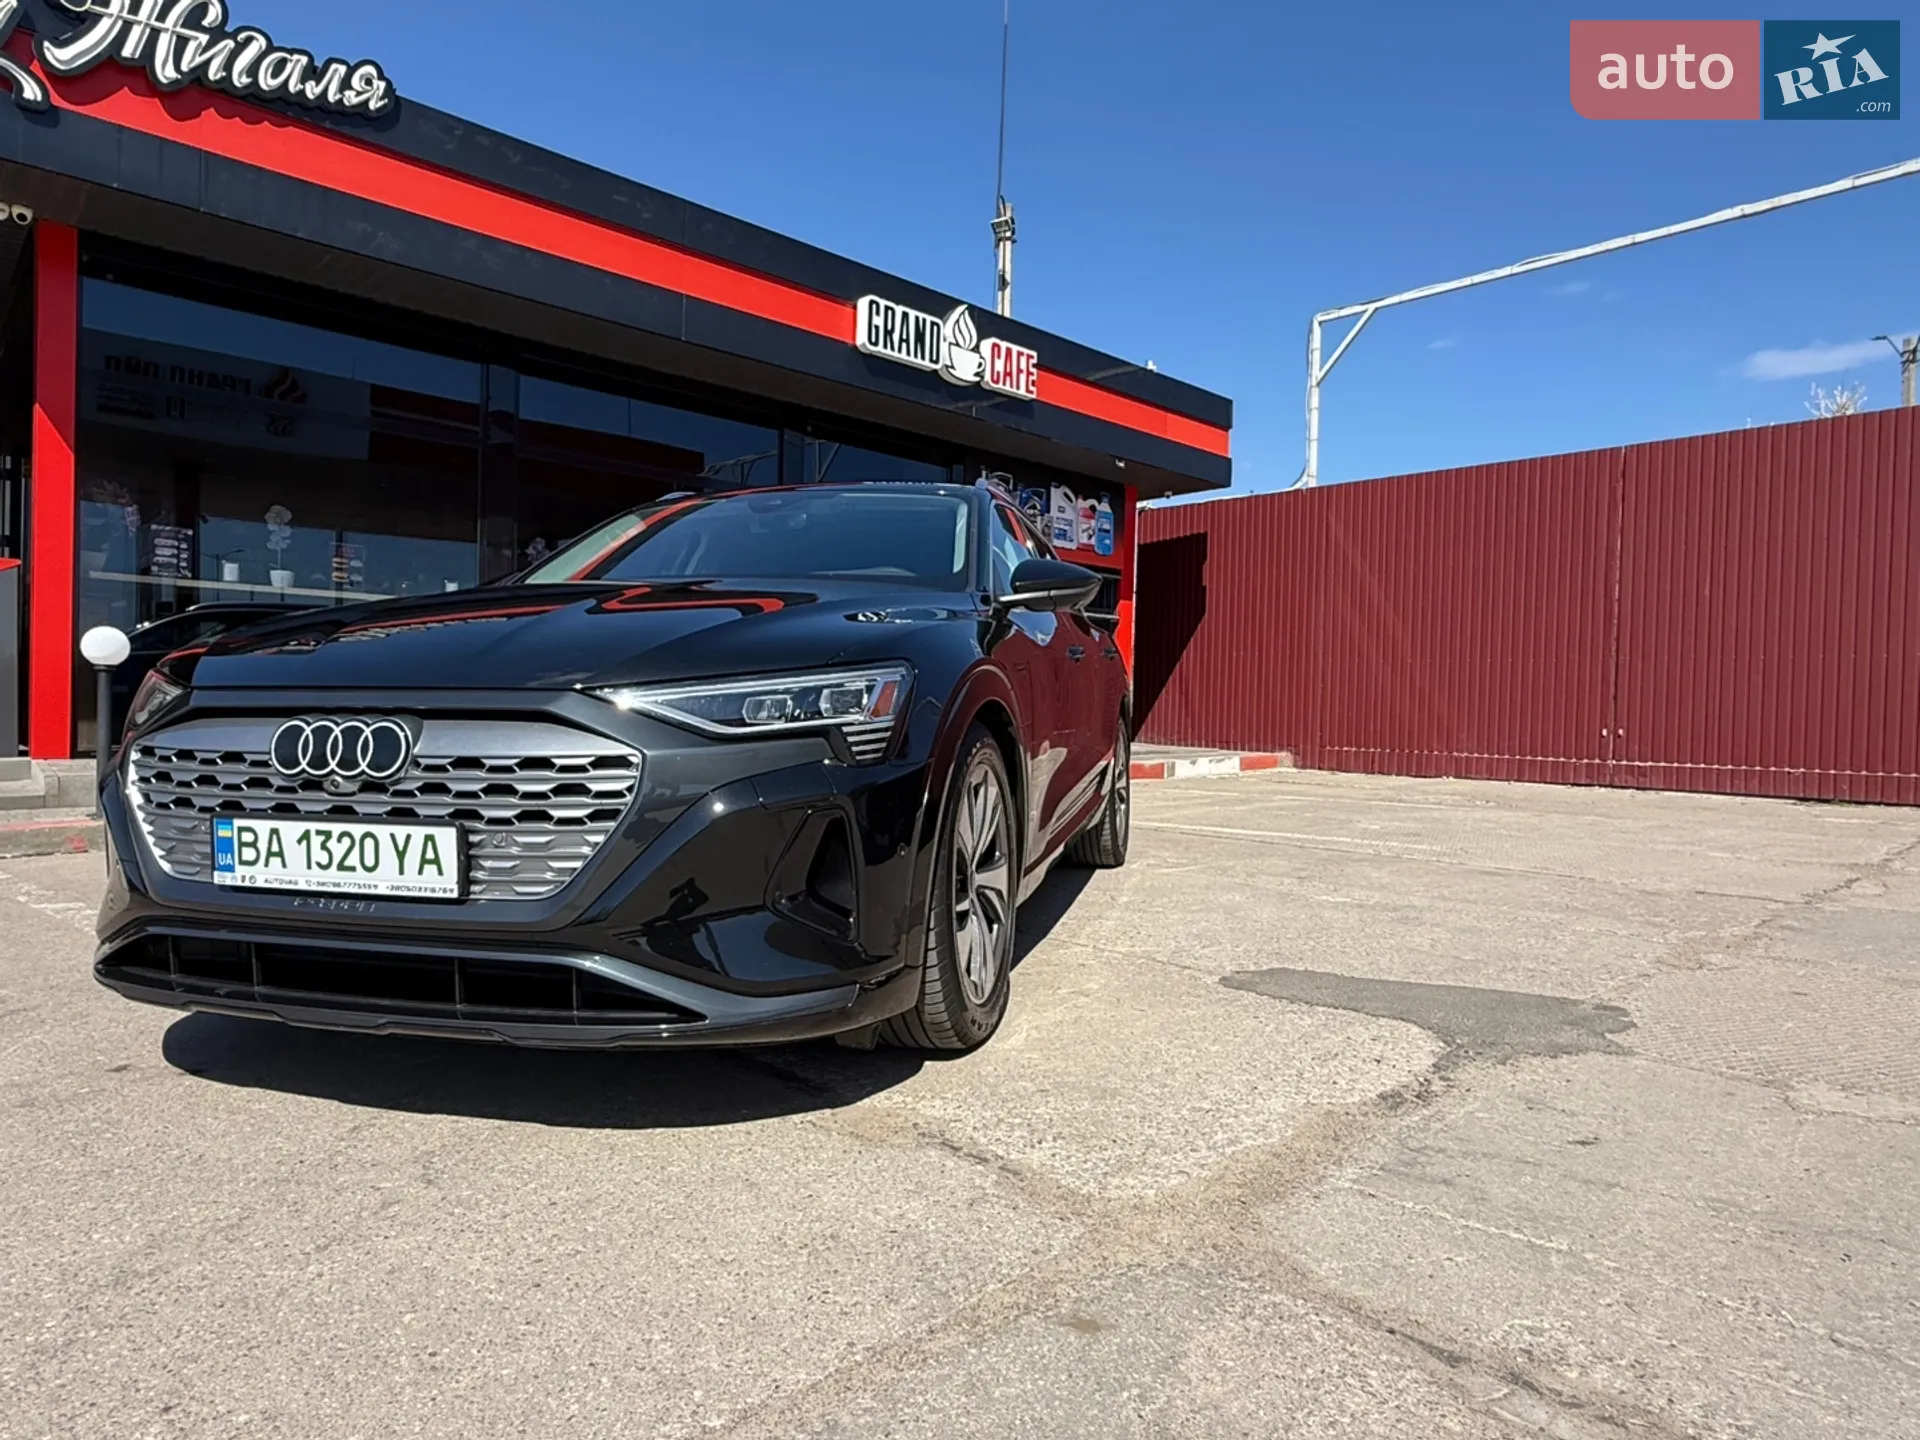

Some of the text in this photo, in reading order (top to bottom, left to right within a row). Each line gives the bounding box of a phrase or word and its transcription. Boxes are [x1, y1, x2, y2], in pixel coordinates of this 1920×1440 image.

[867, 300, 1035, 395] GRAND CAFE
[218, 853, 234, 866] UA
[237, 826, 444, 877] BA 1320 YA
